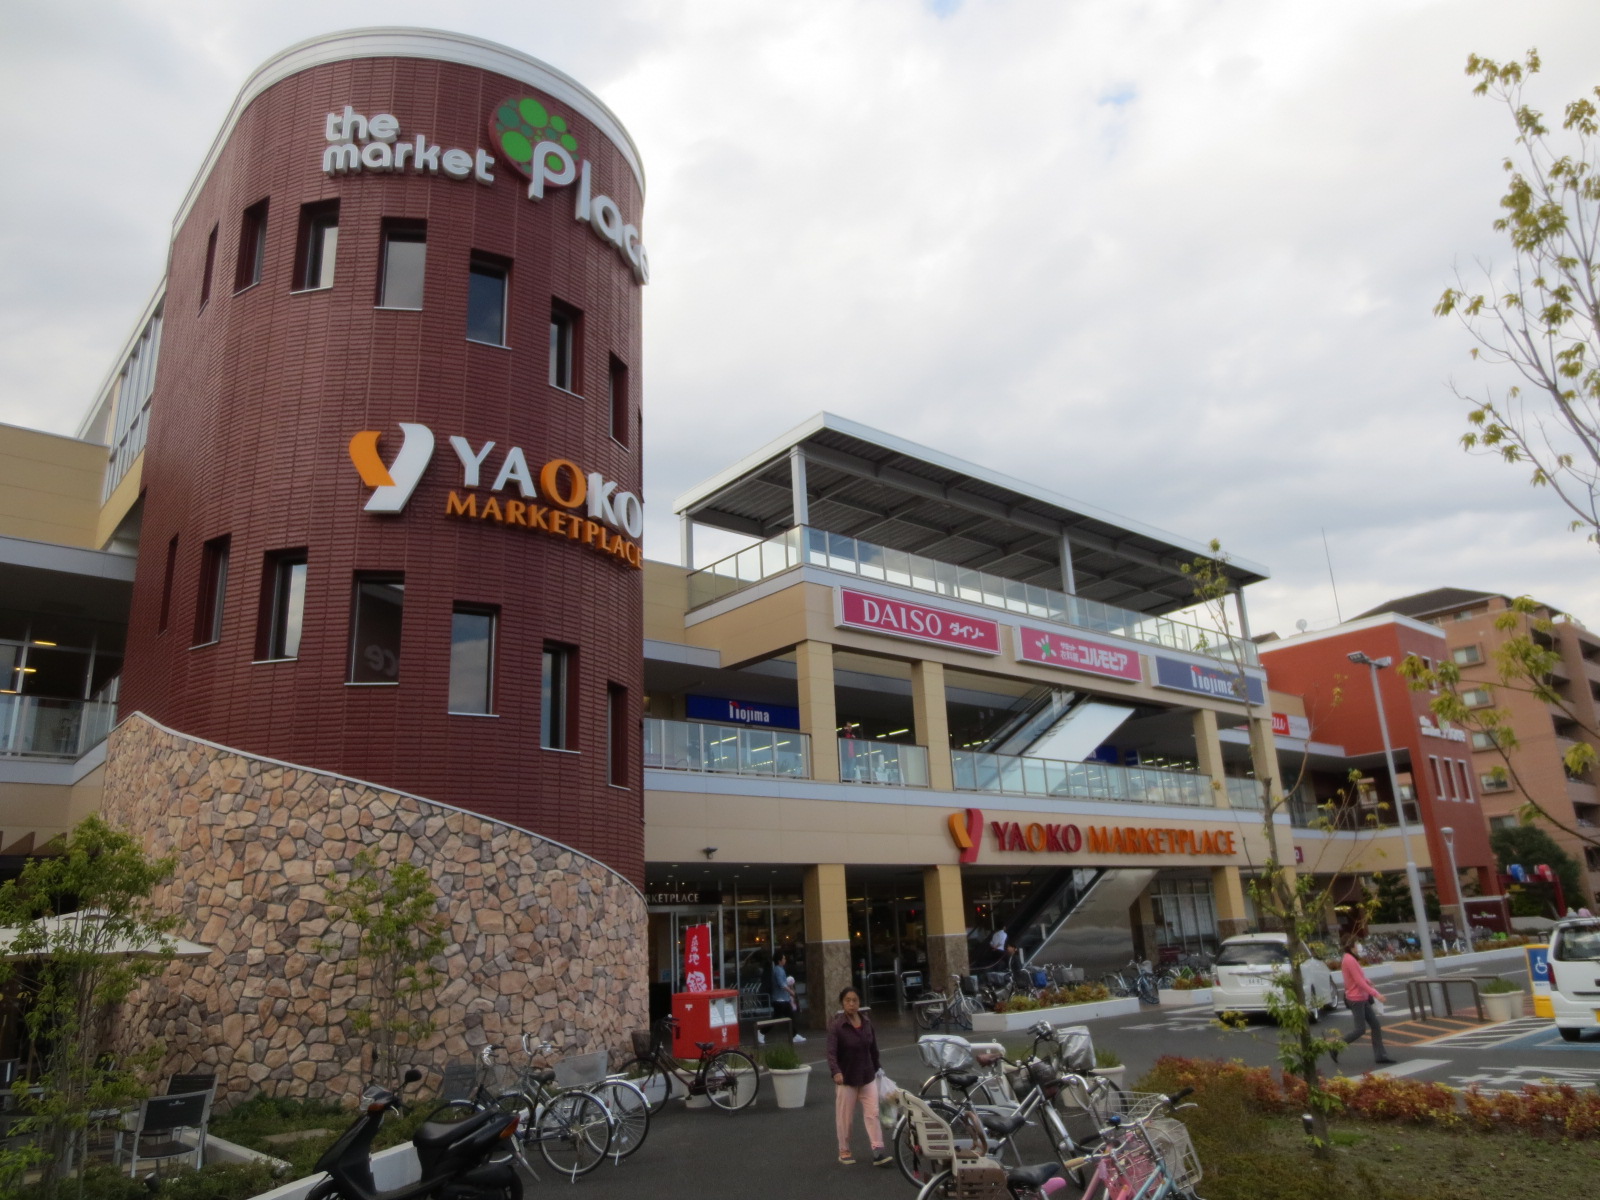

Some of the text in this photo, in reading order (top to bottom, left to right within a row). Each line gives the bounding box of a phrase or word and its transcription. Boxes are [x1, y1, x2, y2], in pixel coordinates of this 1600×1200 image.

[325, 106, 400, 143] the
[323, 135, 650, 286] market place
[449, 435, 643, 539] YAOKO
[445, 490, 643, 570] MARKETPLACE
[862, 599, 985, 640] DAISO ダイソー
[991, 821, 1083, 853] YAOKO
[1087, 825, 1237, 856] MARKETPLACE
[645, 893, 701, 904] RKETPLACE
